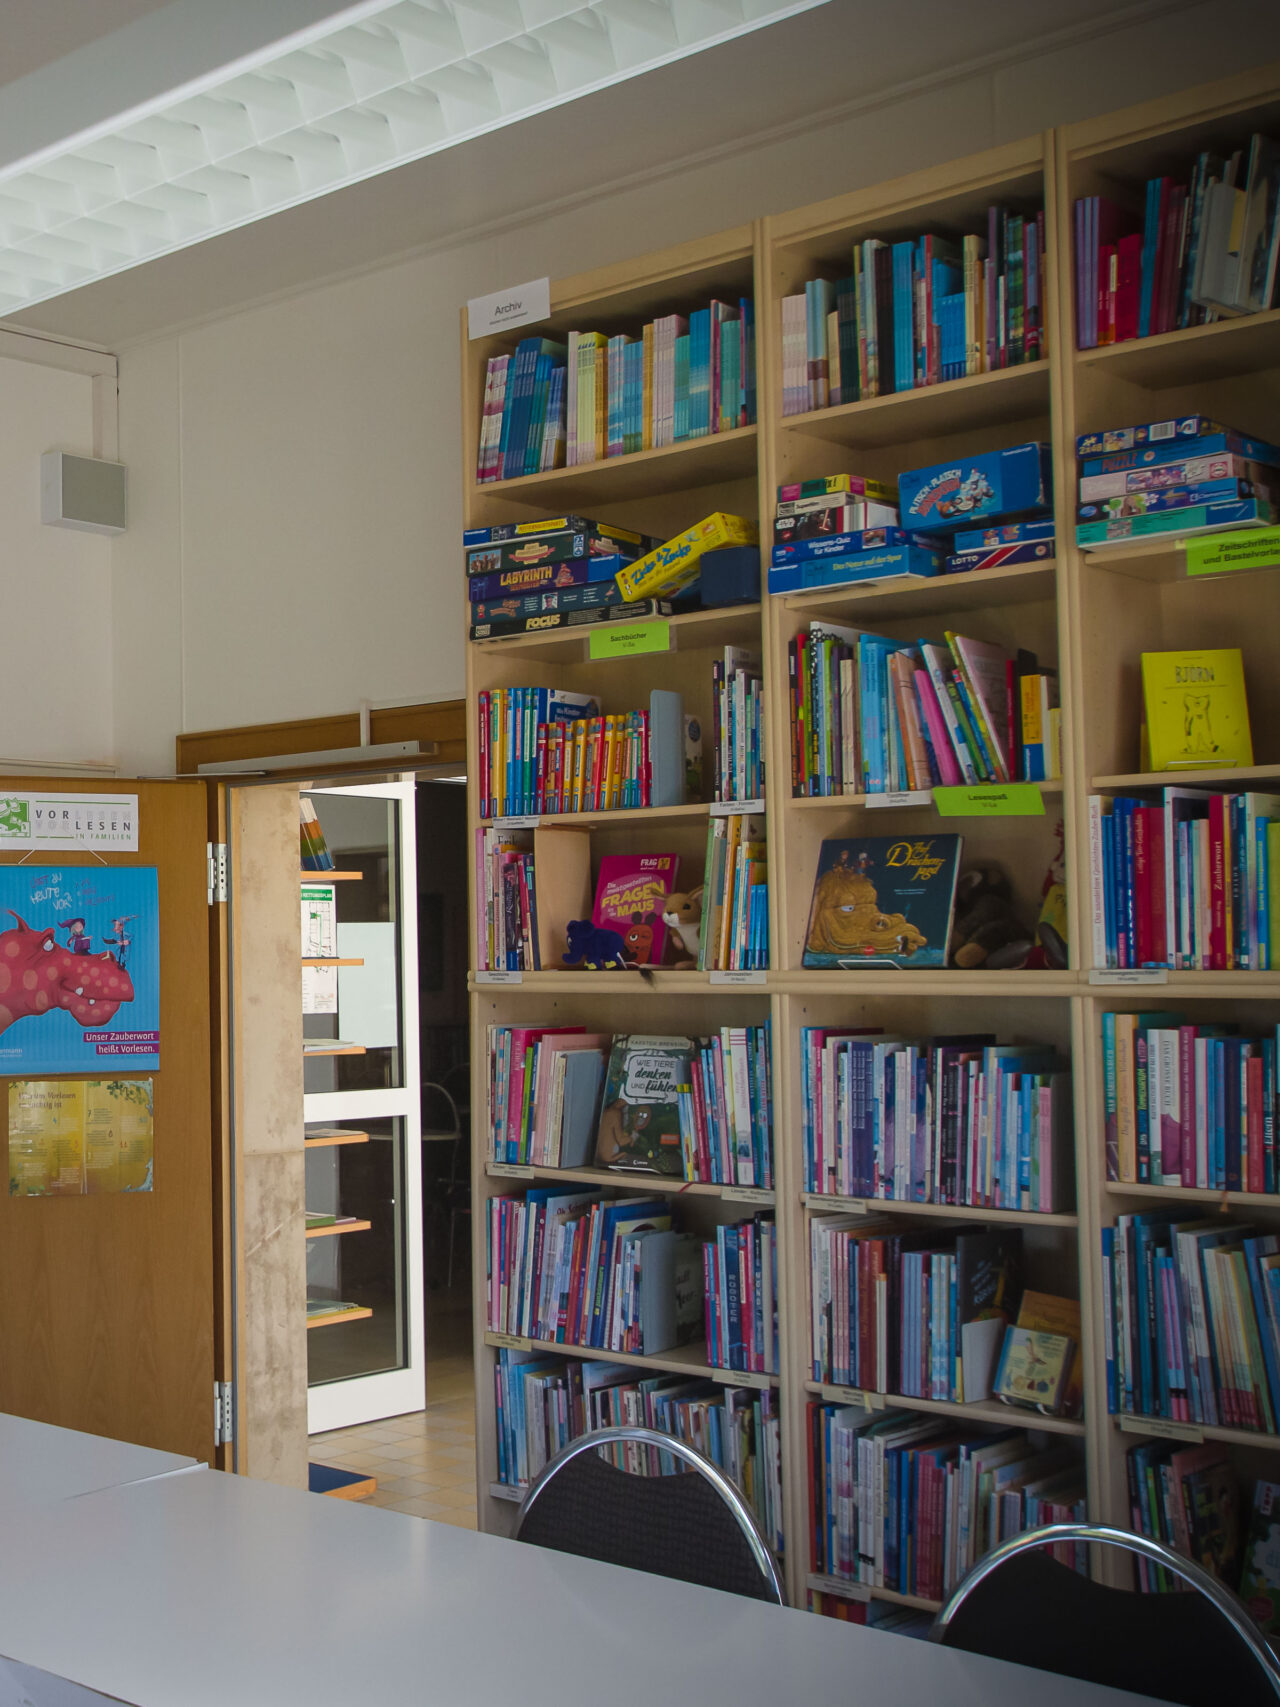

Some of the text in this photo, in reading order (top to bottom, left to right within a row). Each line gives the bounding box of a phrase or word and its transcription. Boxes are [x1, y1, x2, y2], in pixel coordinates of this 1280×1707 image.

[494, 301, 523, 316] Archiv
[1218, 537, 1280, 553] Zeitschriften
[951, 555, 979, 565] LOTTO
[1203, 548, 1280, 565] und Bastelvorla
[500, 566, 553, 587] LABYRINTH
[525, 614, 561, 630] FOCUS
[610, 632, 647, 643] Sachbücher
[35, 810, 70, 819] VOR
[75, 821, 131, 831] LESEN
[90, 833, 132, 841] FAMILIEN
[640, 858, 658, 867] FRAG
[1214, 841, 1223, 891] Zauberwort
[601, 879, 666, 909] FRAGEN
[617, 899, 655, 917] MAUS
[86, 1031, 155, 1042] Unser Zauberwort
[98, 1044, 156, 1054] heißt Vorlesen.
[636, 1059, 675, 1068] WIE TIERE
[634, 1069, 673, 1079] denken
